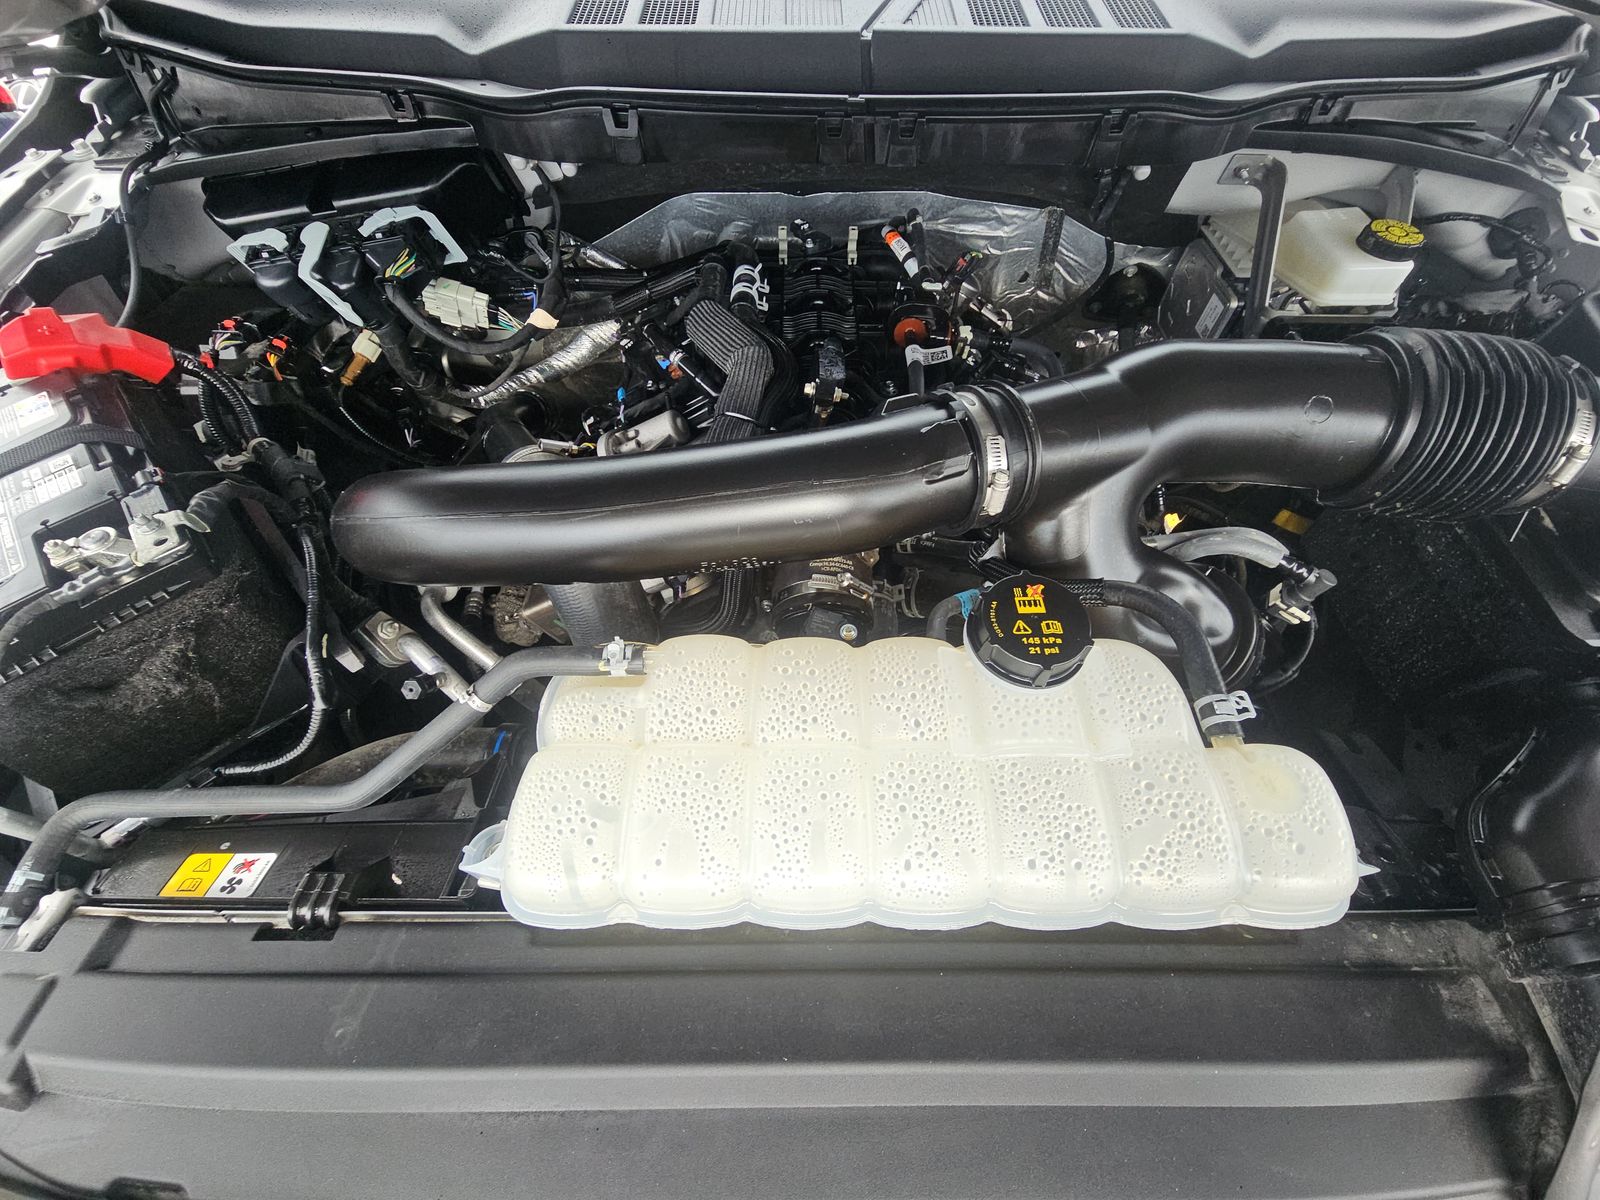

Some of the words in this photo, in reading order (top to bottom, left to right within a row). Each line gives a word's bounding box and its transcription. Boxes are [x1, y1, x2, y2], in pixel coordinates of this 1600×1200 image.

[1022, 637, 1041, 645] 145
[1042, 636, 1063, 644] kPa
[1028, 646, 1041, 654] 21
[1044, 646, 1060, 656] psi
